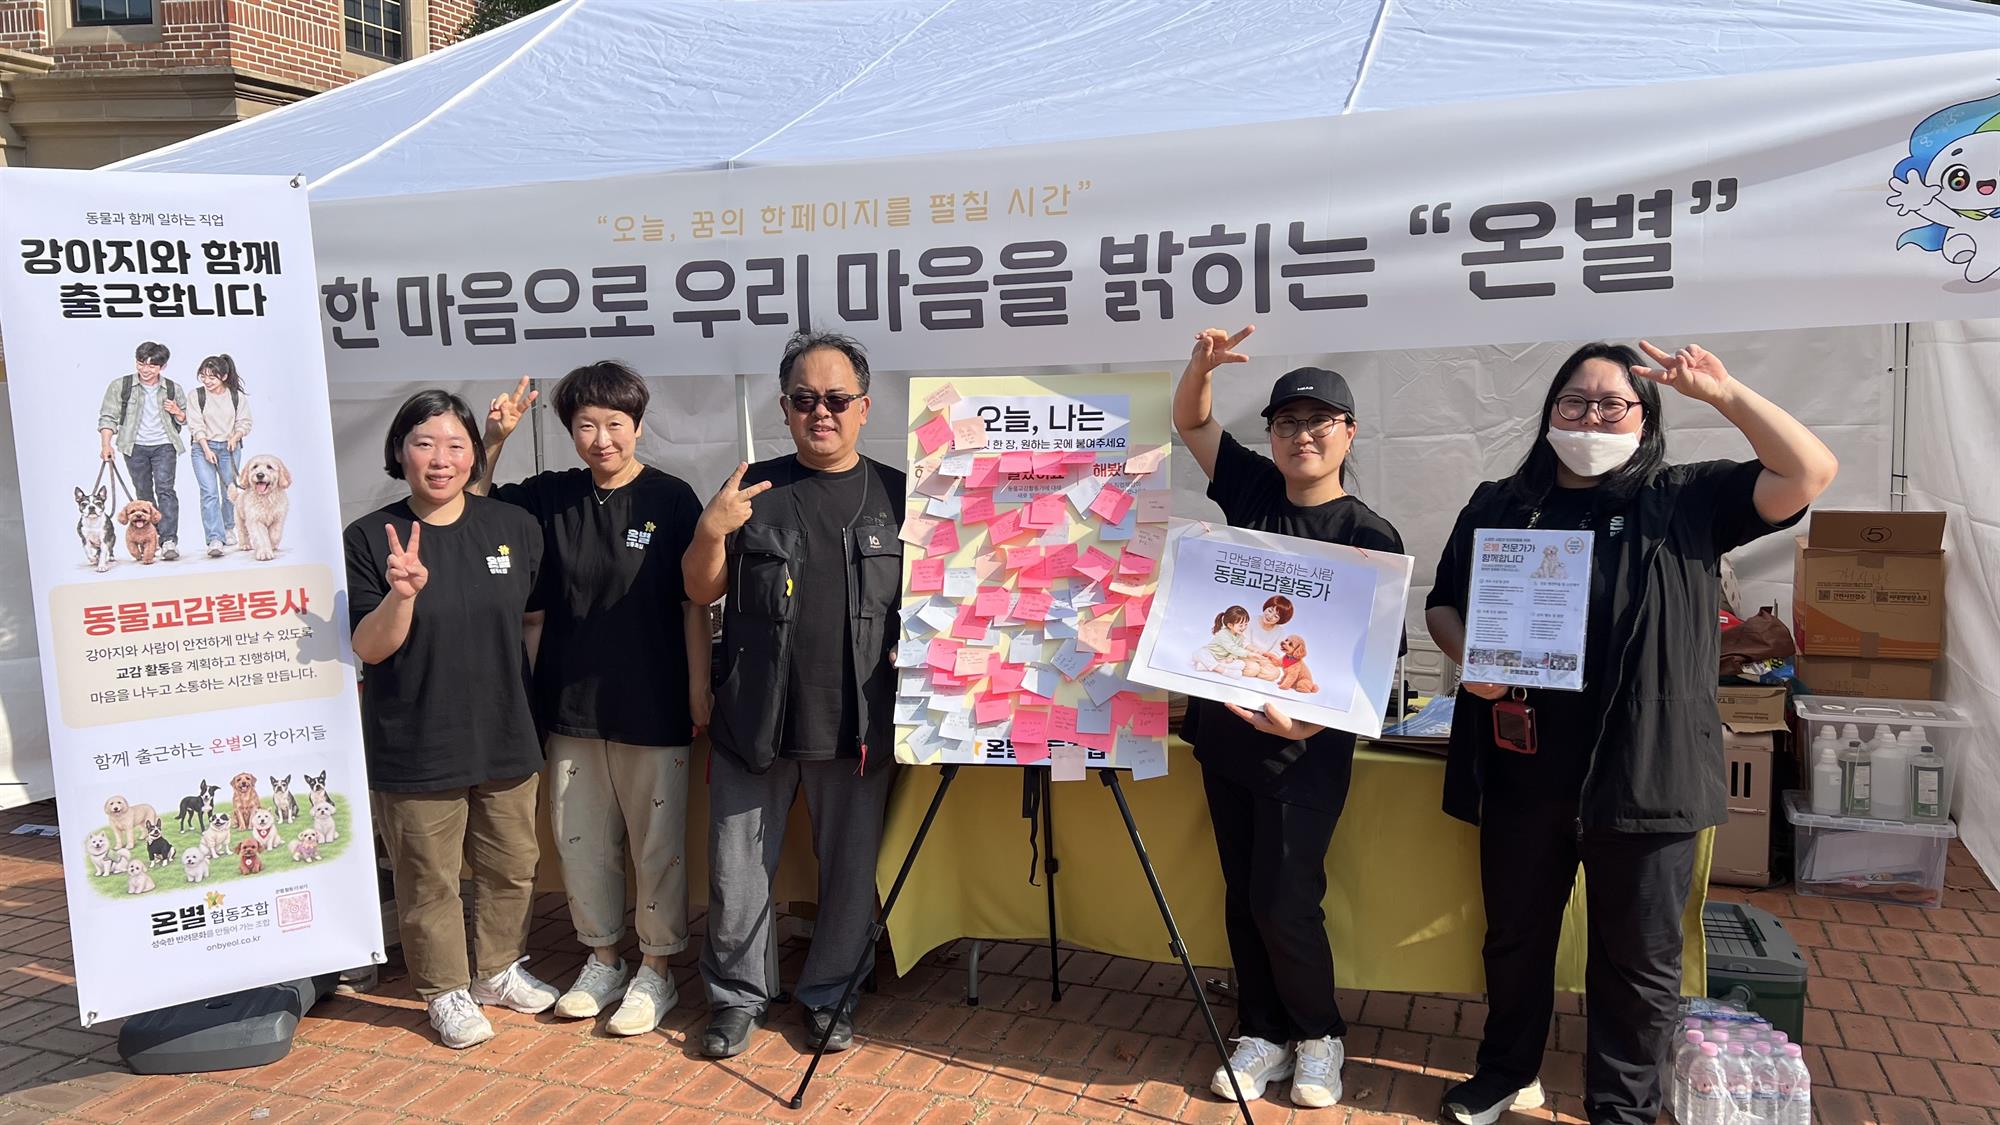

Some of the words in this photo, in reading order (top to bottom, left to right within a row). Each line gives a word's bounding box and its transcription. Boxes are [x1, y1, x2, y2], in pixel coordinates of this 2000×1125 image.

[86, 212, 125, 225] 동물과
[129, 213, 154, 226] 함께
[157, 213, 196, 226] 일하는
[199, 213, 224, 227] 직업
[691, 209, 745, 239] 꿈의
[760, 195, 912, 236] 한페이지를
[928, 190, 991, 225] 펼칠
[21, 238, 191, 275] 강아지와
[201, 240, 281, 275] 함께
[321, 276, 380, 349] 한
[397, 264, 655, 346] 마음으로
[673, 253, 811, 336] 우리
[836, 239, 1074, 331] 마음을
[1100, 220, 1375, 323] 밝히는
[1410, 177, 1739, 302] “온별”
[60, 282, 267, 318] 출근합니다
[1049, 404, 1105, 432] 나는
[993, 440, 1003, 450] 한
[1021, 439, 1051, 450] 원하는
[1053, 439, 1073, 450] 곳에
[1076, 437, 1126, 450] 붙여주세요
[1482, 553, 1524, 563] 함께합니다
[1502, 543, 1536, 553] 전문가가
[1214, 564, 1331, 601] 동물교감활동가
[1216, 551, 1228, 563] 그
[1229, 552, 1261, 570] 만남을
[1264, 558, 1308, 577] 연결하는
[1311, 566, 1334, 582] 사람
[83, 588, 309, 636] 동물교감활동사
[86, 644, 137, 662] 강아지와
[141, 640, 179, 655] 사람이
[183, 635, 232, 651] 안전하게
[236, 631, 259, 645] 만날
[263, 630, 274, 643] 수
[278, 627, 313, 641] 있도록
[116, 665, 142, 680] 교감
[145, 661, 183, 676] 활동을
[187, 655, 236, 671] 계획하고
[239, 650, 290, 665] 진행하며,
[90, 688, 130, 704] 마음을
[133, 684, 171, 699] 나누고
[175, 678, 224, 694] 소통하는
[228, 673, 263, 688] 시간을
[267, 667, 317, 683] 만듭니다.
[93, 751, 129, 771] 함께
[135, 743, 204, 765] 출근하는
[209, 733, 257, 754] 온별의
[264, 725, 326, 747] 강아지들
[151, 904, 206, 936] 온별
[210, 901, 269, 925] 협동조합
[151, 937, 174, 949] 성숙한
[215, 924, 238, 937] 만들어
[239, 922, 254, 932] 가는
[206, 935, 262, 951] onbyeol.co.kr
